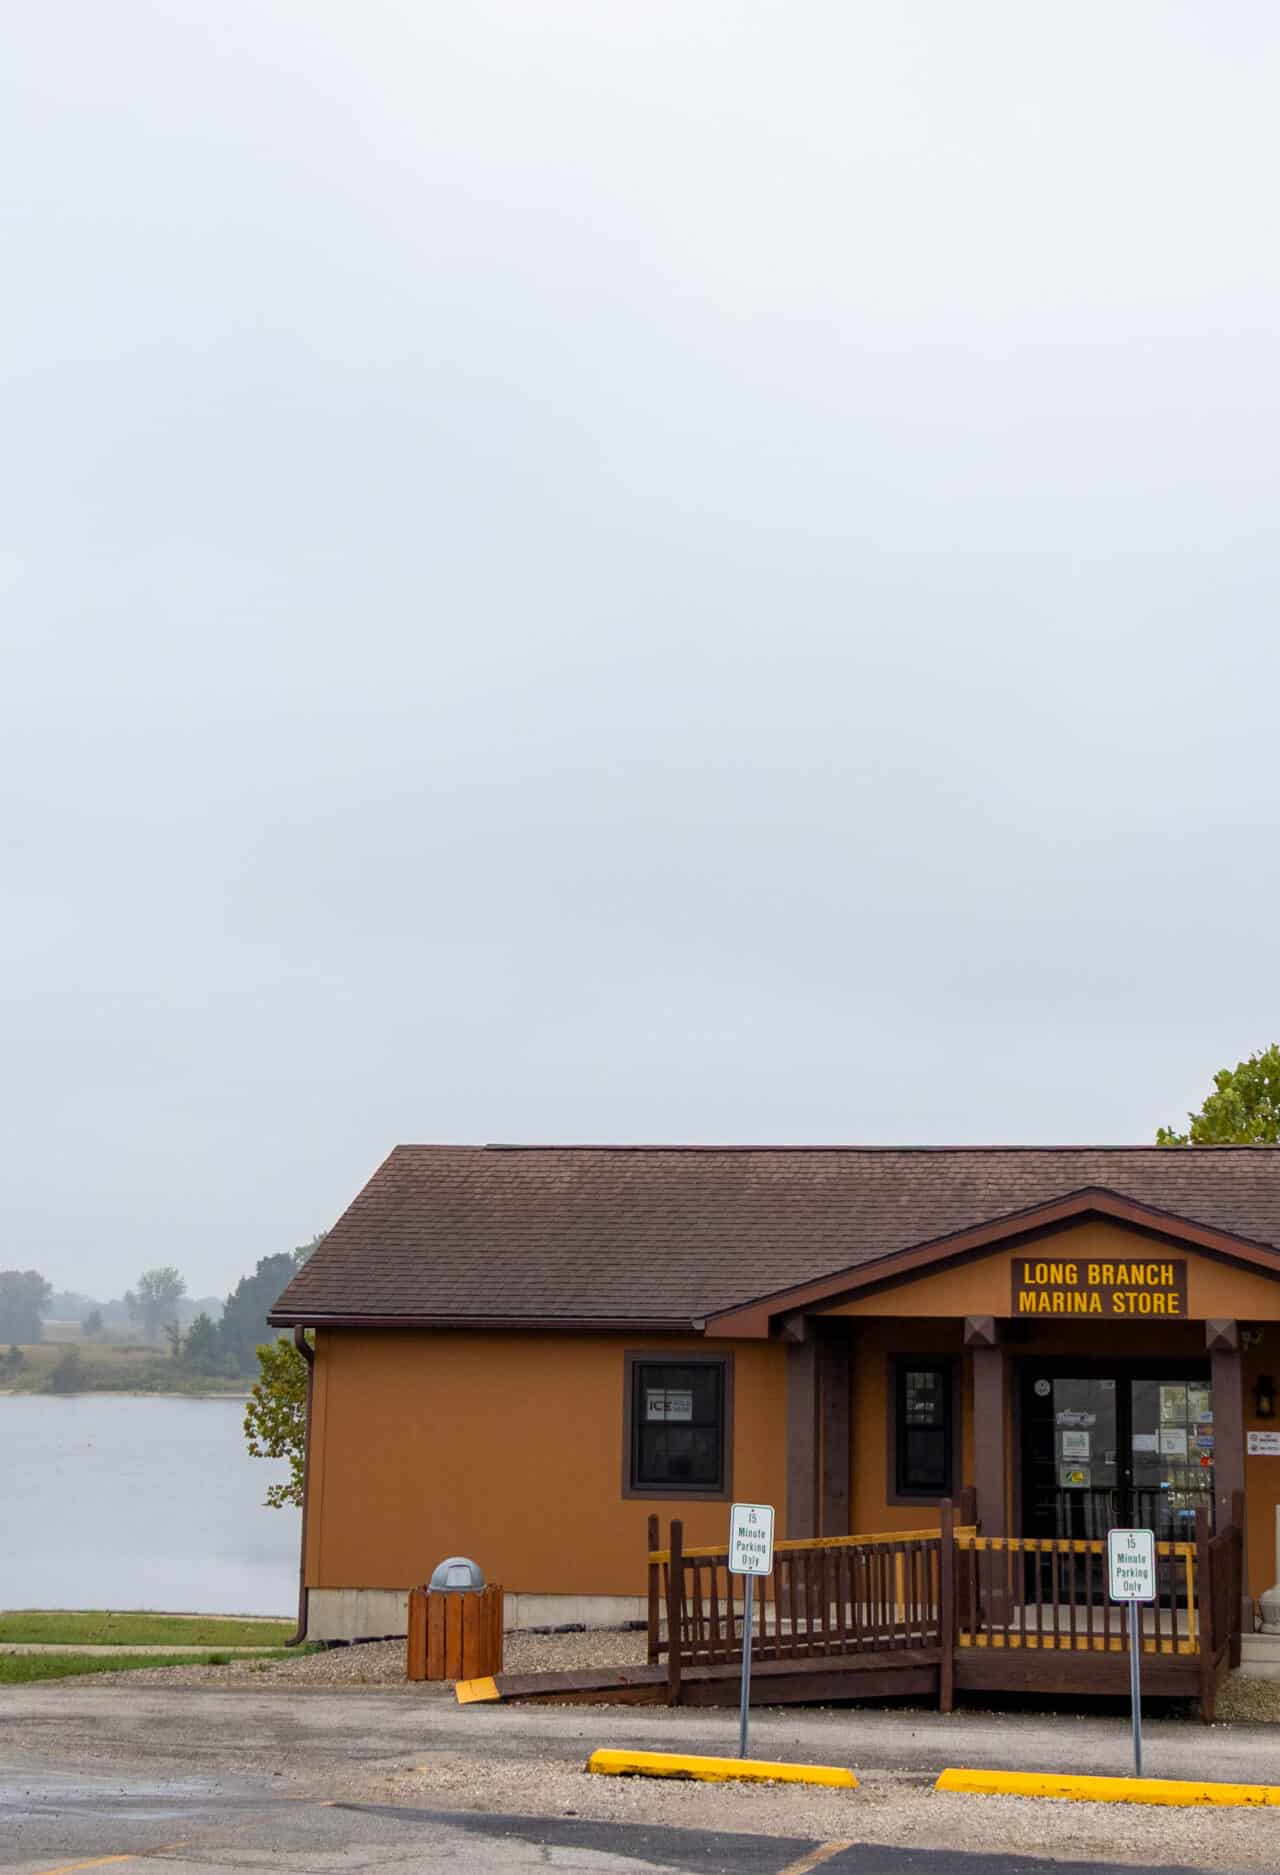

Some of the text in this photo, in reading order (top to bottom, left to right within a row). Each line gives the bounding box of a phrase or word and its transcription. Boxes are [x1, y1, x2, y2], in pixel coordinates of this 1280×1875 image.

[1023, 1263, 1174, 1286] LONG BRANCH
[1018, 1291, 1180, 1314] MARINA STORE
[748, 1512, 758, 1525] 15
[738, 1527, 766, 1539] Minute
[736, 1540, 766, 1554] Parking
[1127, 1538, 1136, 1549] 15
[742, 1554, 760, 1567] Only
[1117, 1553, 1147, 1564] Minute
[1116, 1567, 1149, 1580] Parking
[1123, 1580, 1142, 1593] Only
